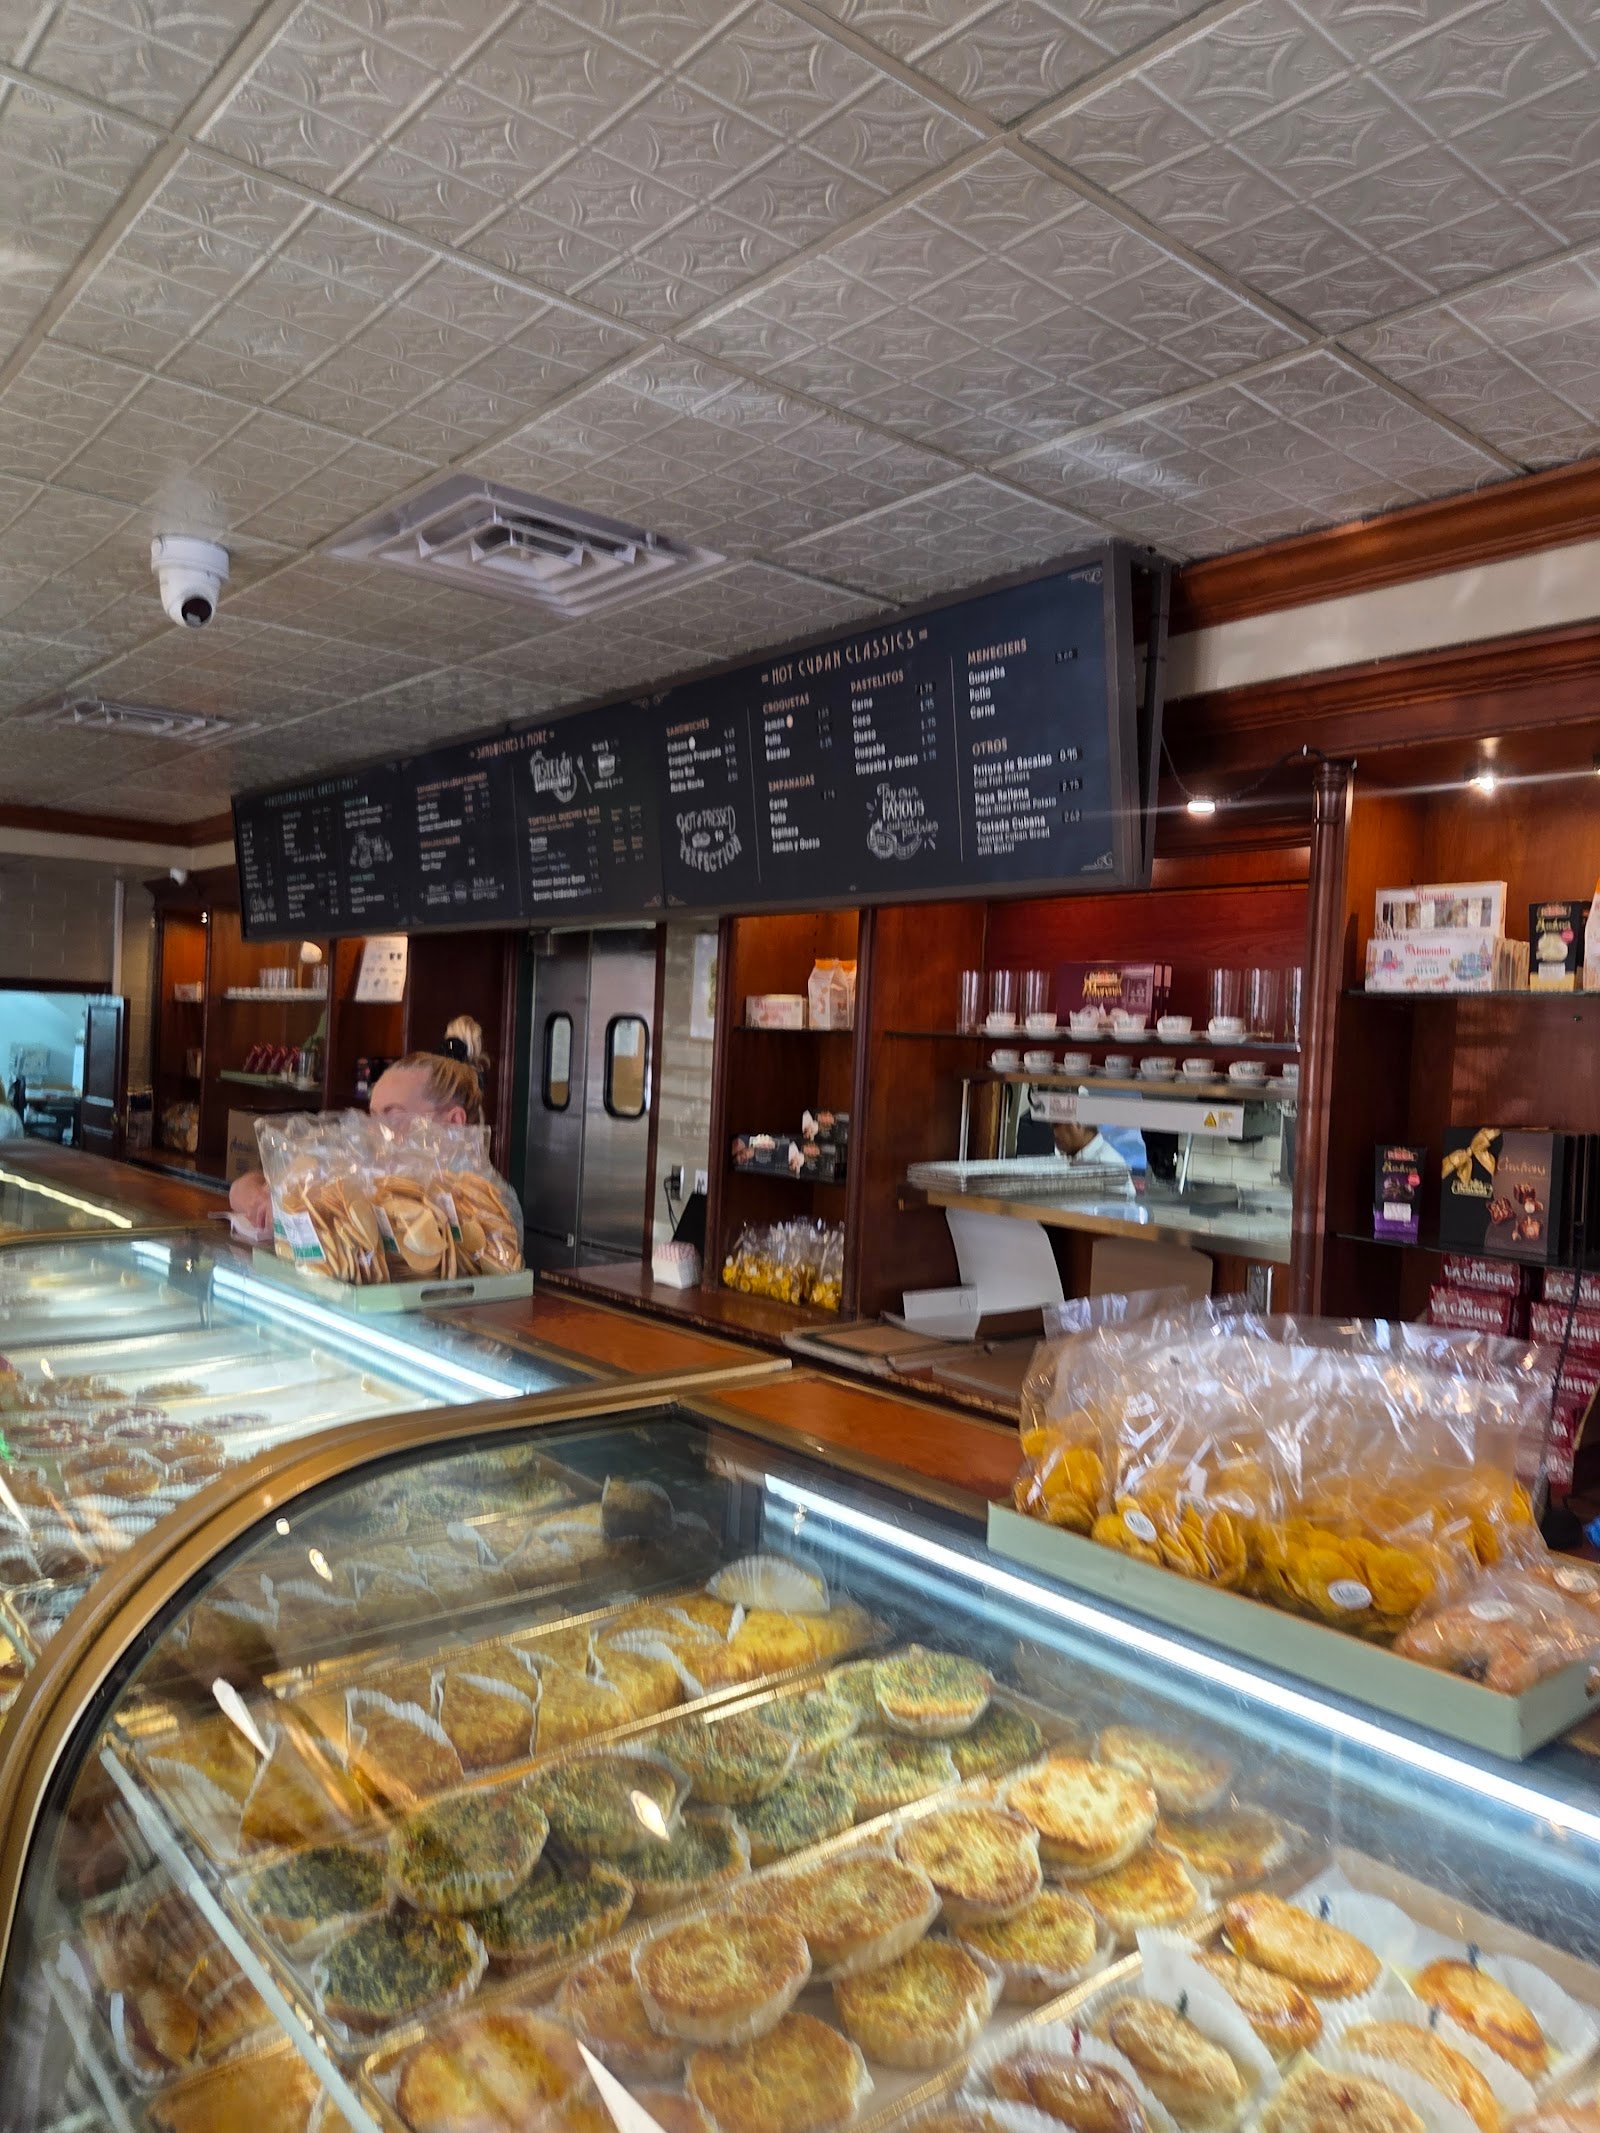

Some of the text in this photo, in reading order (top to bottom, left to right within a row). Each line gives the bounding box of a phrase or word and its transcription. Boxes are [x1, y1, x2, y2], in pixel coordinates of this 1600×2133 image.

[772, 629, 914, 686] HOT CUBAN CLASSICS
[850, 669, 904, 694] PASTELITOS
[968, 665, 1005, 686] Guayaba
[763, 691, 810, 715] CROQUETAS
[969, 685, 991, 703] Pollo
[972, 737, 1008, 757] OTROS
[768, 774, 815, 792] EMPANADAS
[882, 798, 925, 820] FAMOUS
[1463, 1266, 1515, 1288] CARRETA
[1450, 1301, 1503, 1324] CARRETA
